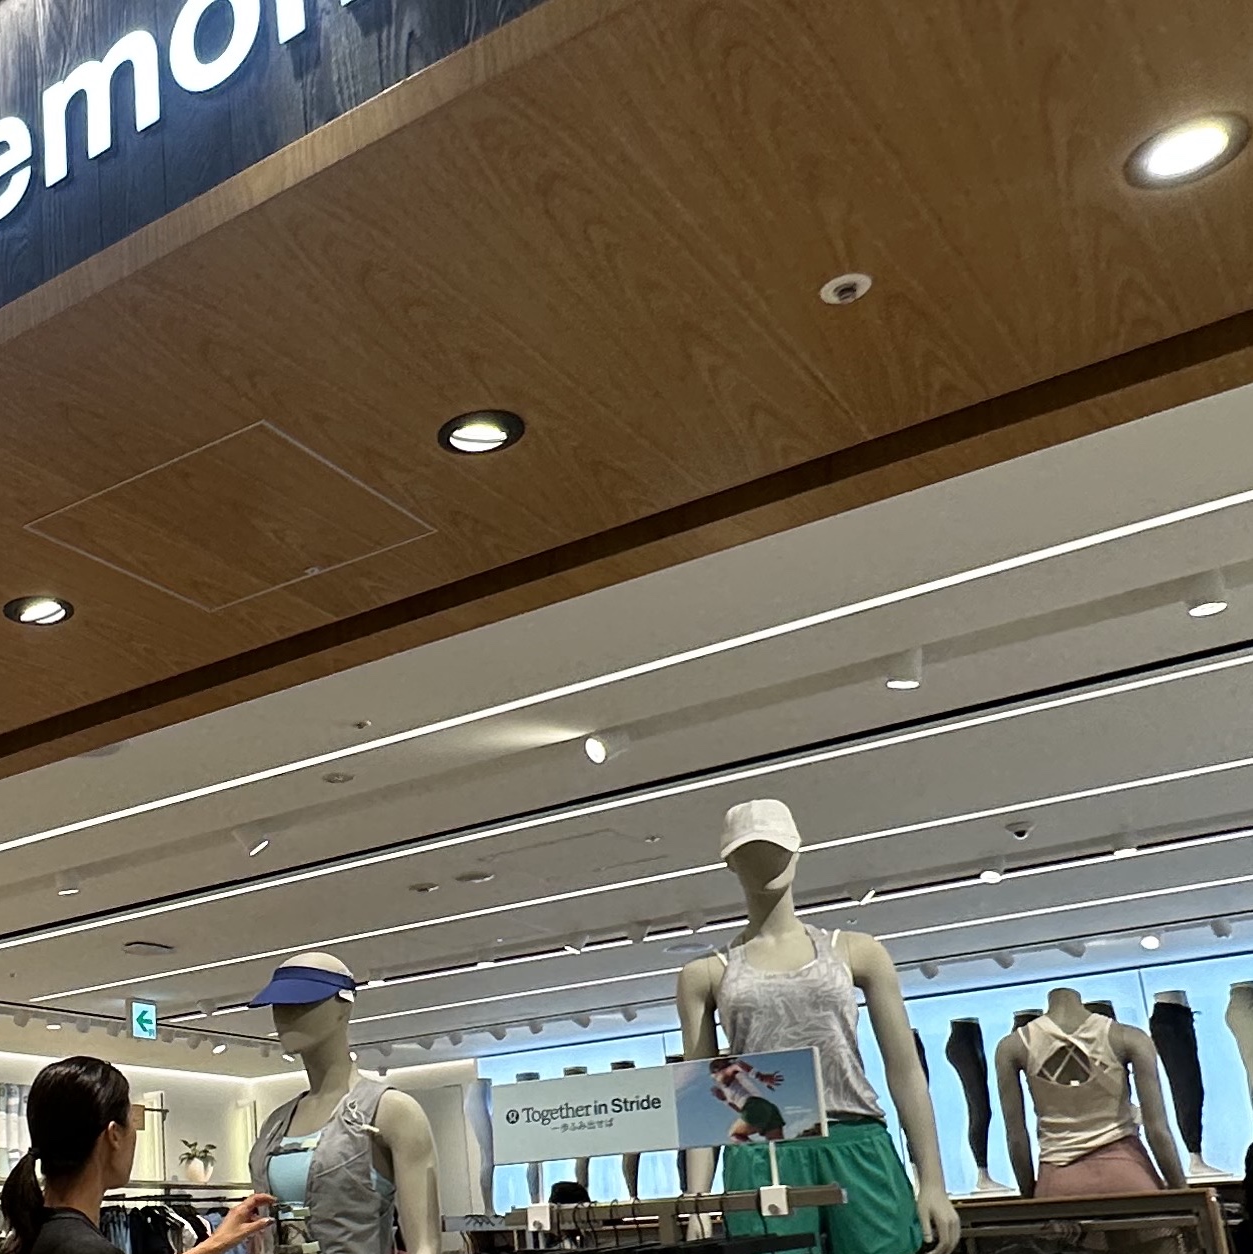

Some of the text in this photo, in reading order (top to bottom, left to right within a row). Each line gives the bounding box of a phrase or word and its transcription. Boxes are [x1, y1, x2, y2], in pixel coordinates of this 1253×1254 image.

[522, 1094, 662, 1126] Together in Stride
